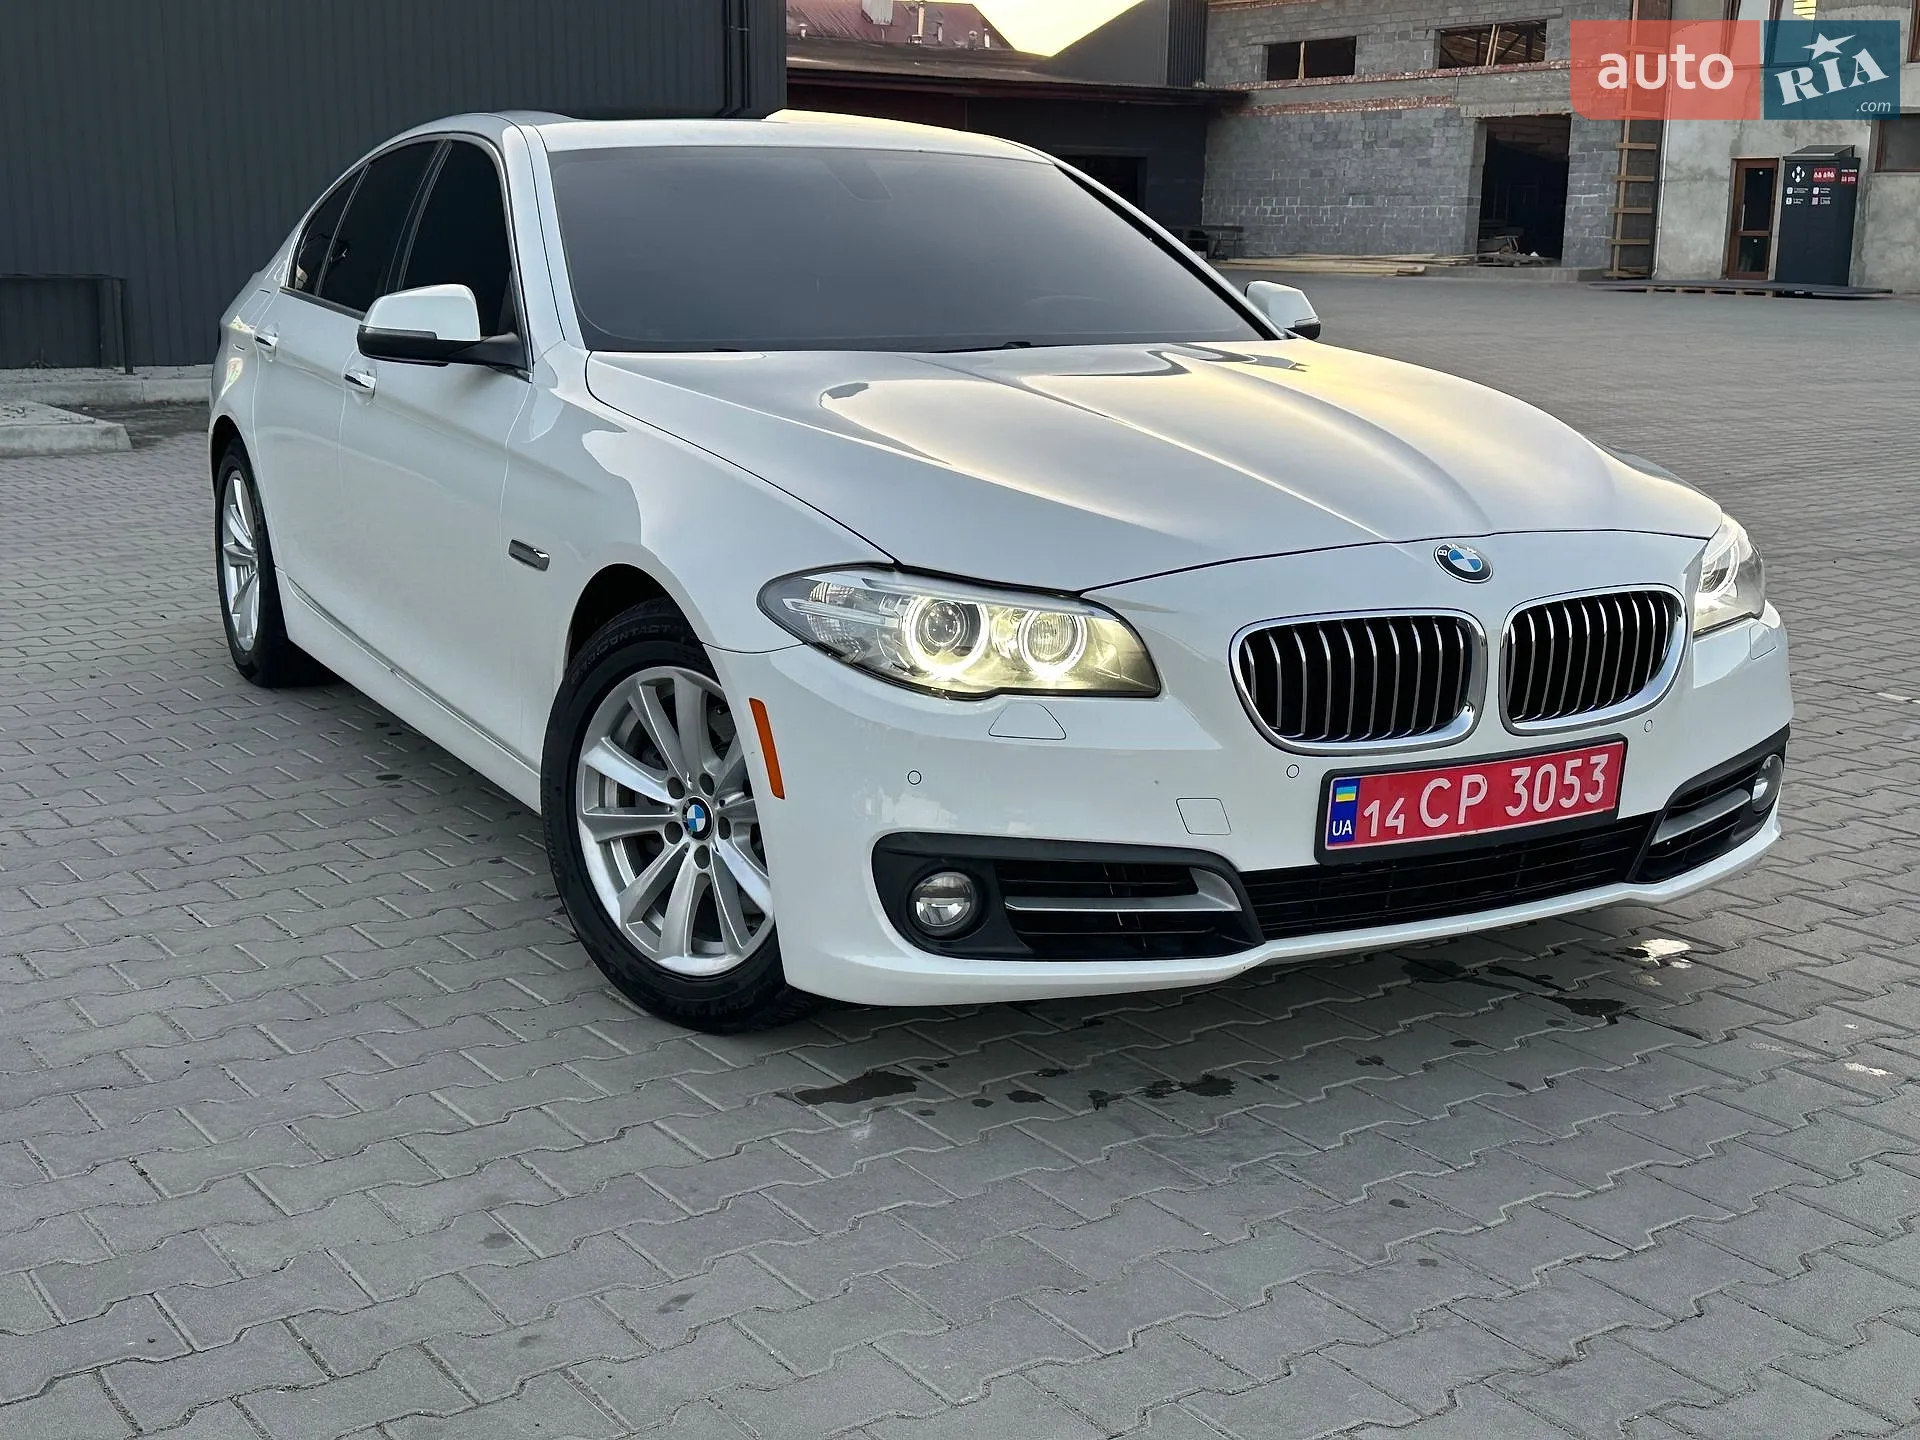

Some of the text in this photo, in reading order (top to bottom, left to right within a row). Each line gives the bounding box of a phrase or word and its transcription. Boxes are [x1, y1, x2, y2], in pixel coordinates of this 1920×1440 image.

[1363, 753, 1609, 837] 14 CP 3053
[1332, 819, 1352, 836] UA
